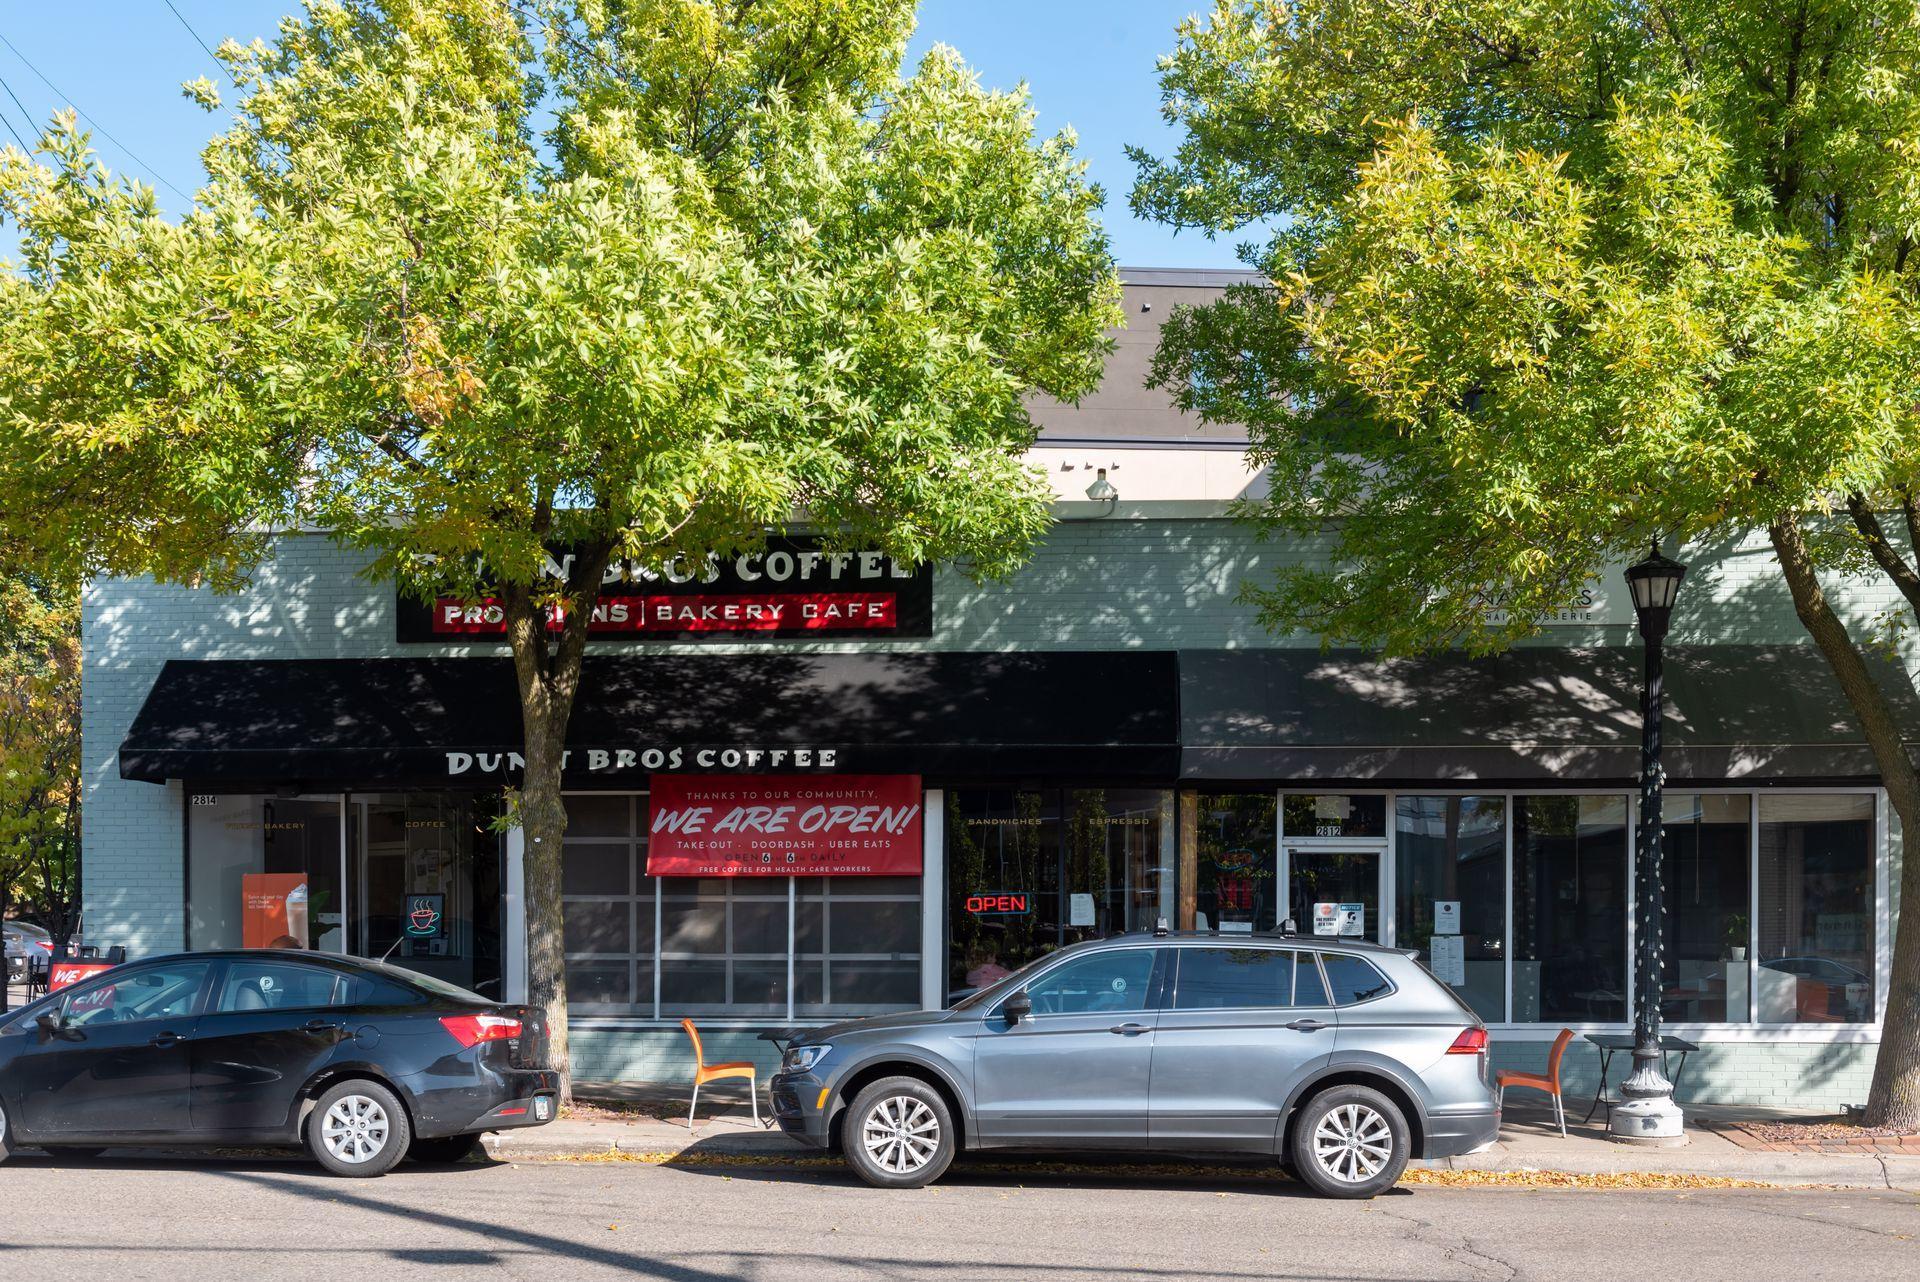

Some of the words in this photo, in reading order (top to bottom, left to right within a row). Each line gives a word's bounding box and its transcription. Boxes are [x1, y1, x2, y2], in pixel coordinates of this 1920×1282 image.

[735, 551, 913, 582] COFFEE
[657, 604, 784, 620] BAKERY
[802, 602, 883, 619] CAFE
[446, 751, 571, 775] DUN
[587, 747, 683, 770] BROS
[696, 749, 837, 768] COFFEE
[193, 795, 217, 805] 2814
[687, 791, 736, 800] THANKS
[743, 791, 757, 799] TO
[764, 791, 790, 799] OUR
[797, 790, 878, 800] COMMUNITY,
[651, 806, 713, 835] WE
[711, 805, 797, 835] ARE
[798, 803, 920, 836] OPEN!
[1317, 826, 1341, 836] 2812
[677, 840, 733, 849] TAKE-OUT
[751, 840, 815, 849] DOORDASH
[829, 840, 858, 849] UBER
[863, 840, 891, 848] EATS
[725, 853, 756, 862] OPEN
[810, 853, 846, 862] DAILY
[966, 895, 1025, 912] OPEN
[53, 969, 80, 984] WE
